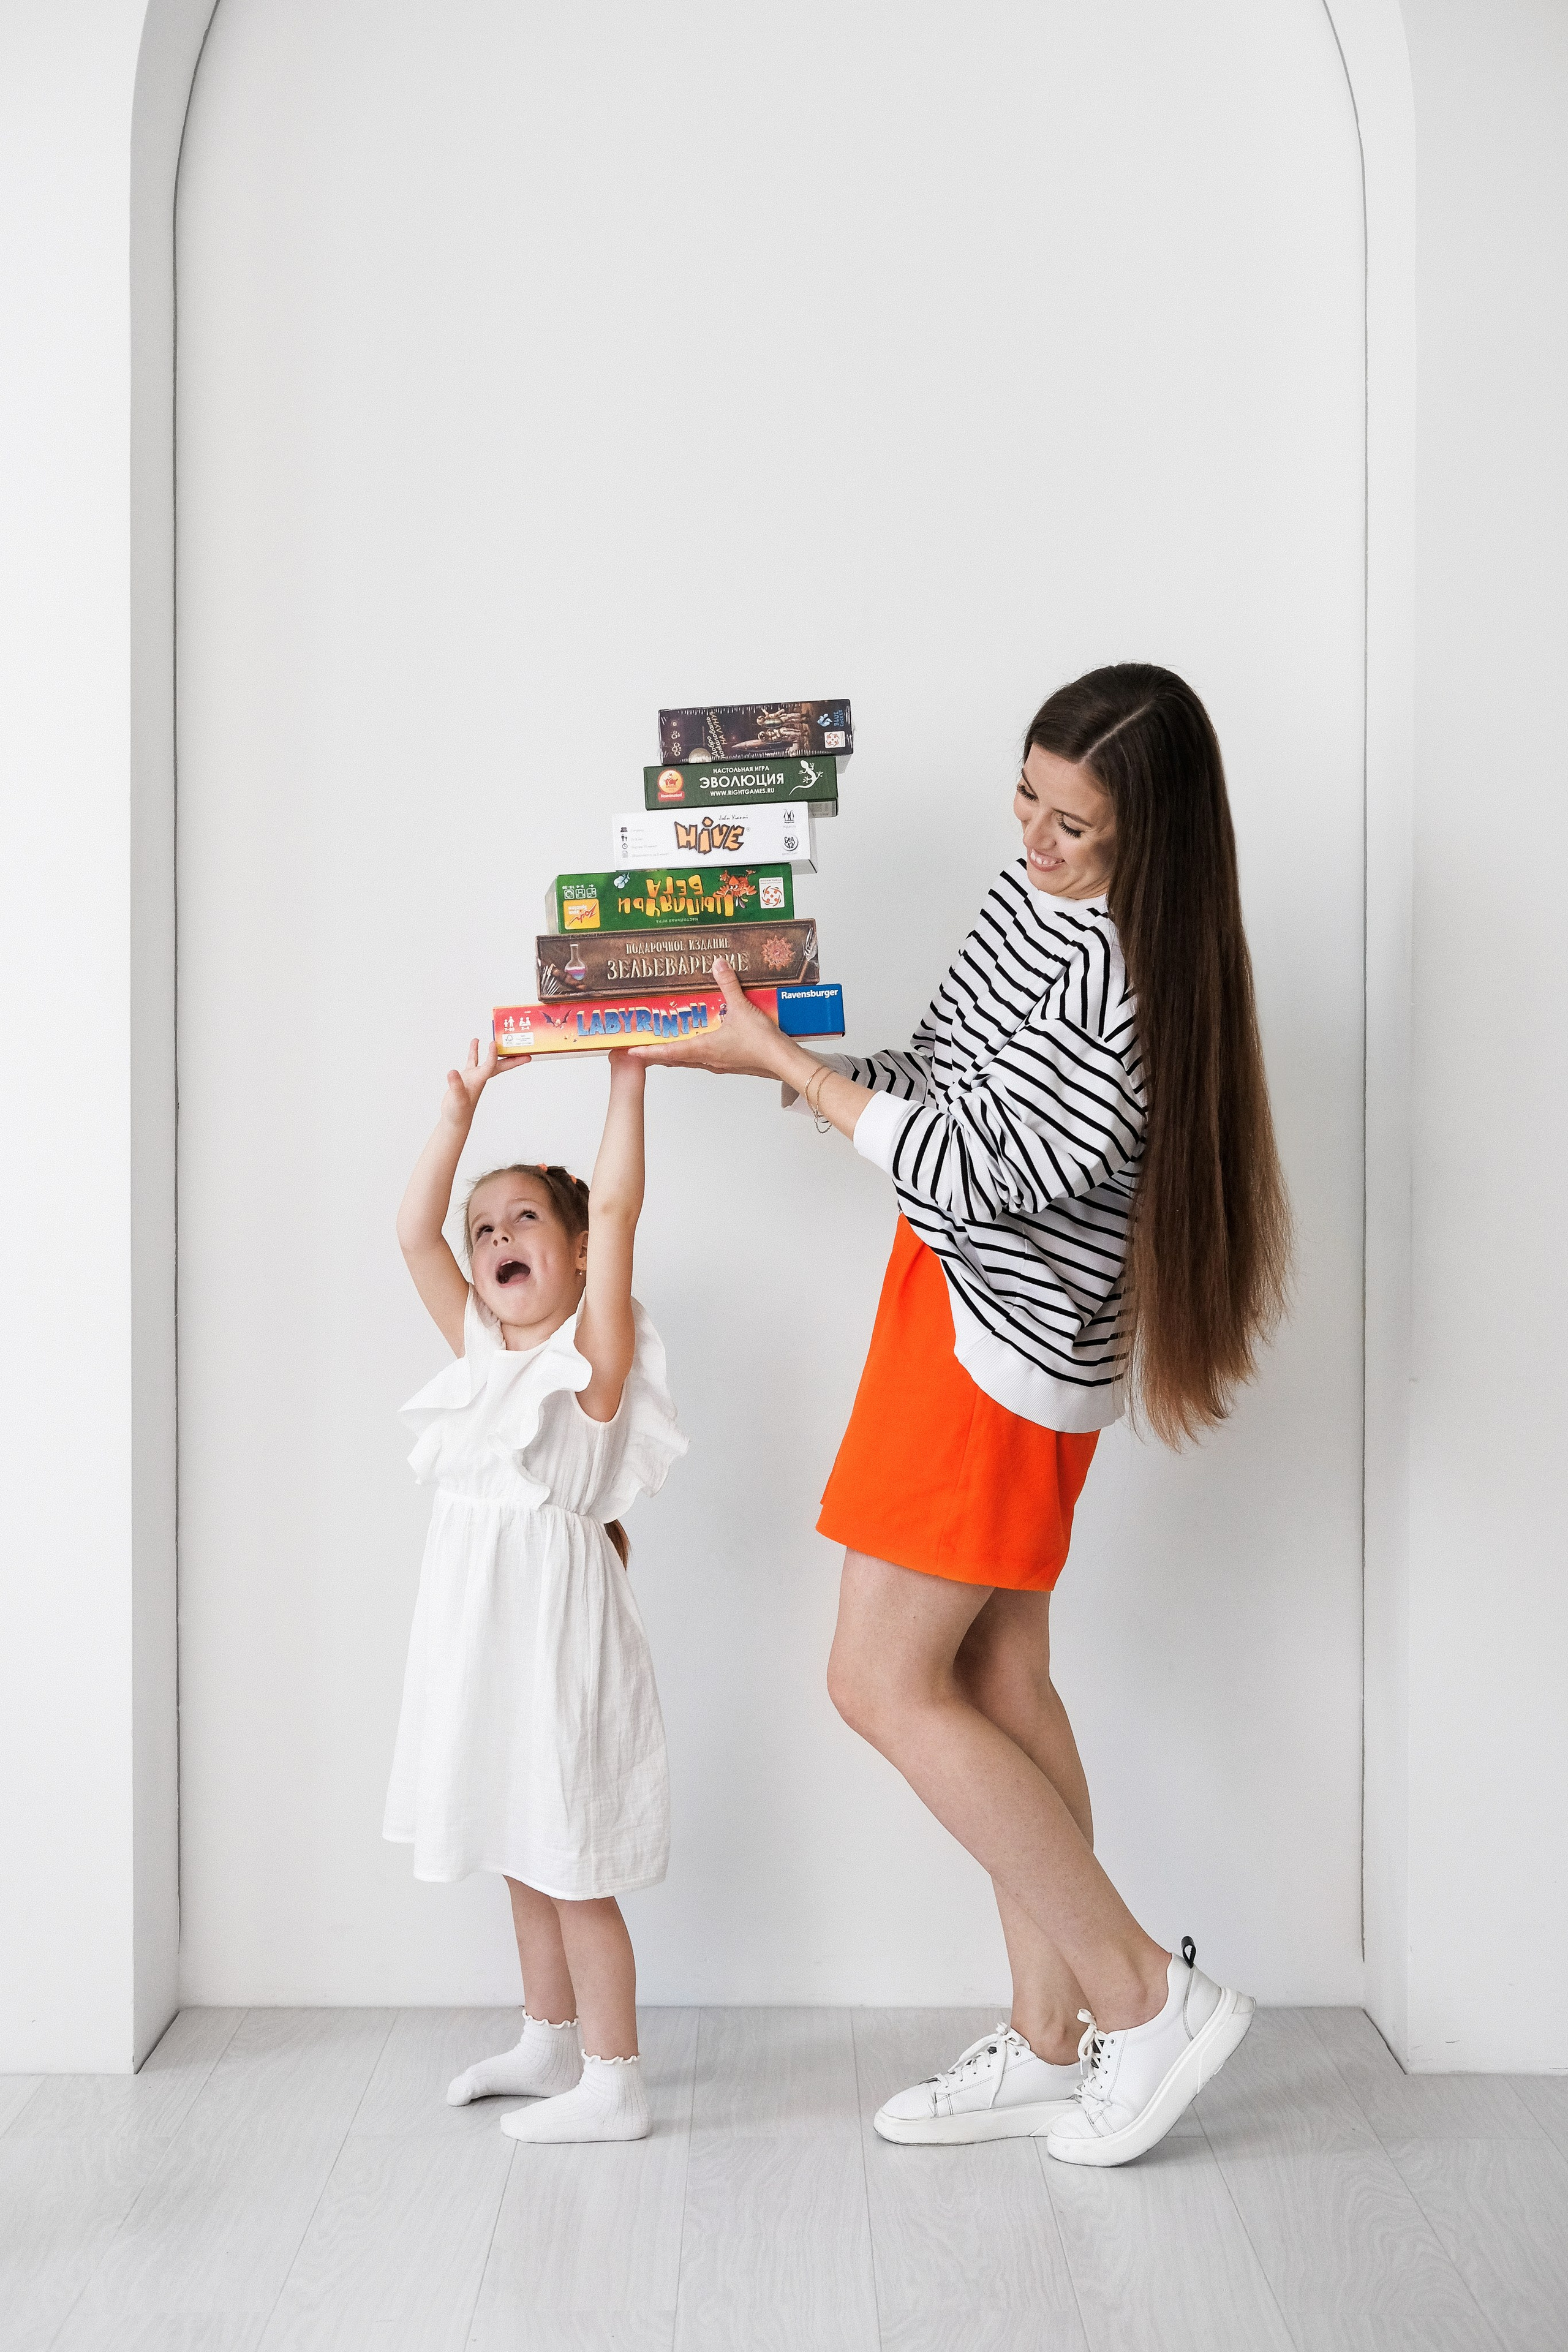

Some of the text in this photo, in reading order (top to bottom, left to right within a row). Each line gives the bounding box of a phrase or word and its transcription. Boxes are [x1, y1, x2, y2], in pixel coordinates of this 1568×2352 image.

[719, 734, 728, 745] НА
[699, 773, 785, 789] ЭВОЛЮЦИЯ
[710, 788, 775, 796] WWW.RIGHTGAMES.RU
[646, 874, 704, 897] БЕГА
[626, 938, 730, 955] ПОДАРОЧНОЕ ИЗДАНИЕ
[781, 989, 839, 1000] Ravensburger
[576, 1002, 708, 1038] LABYRINTH
